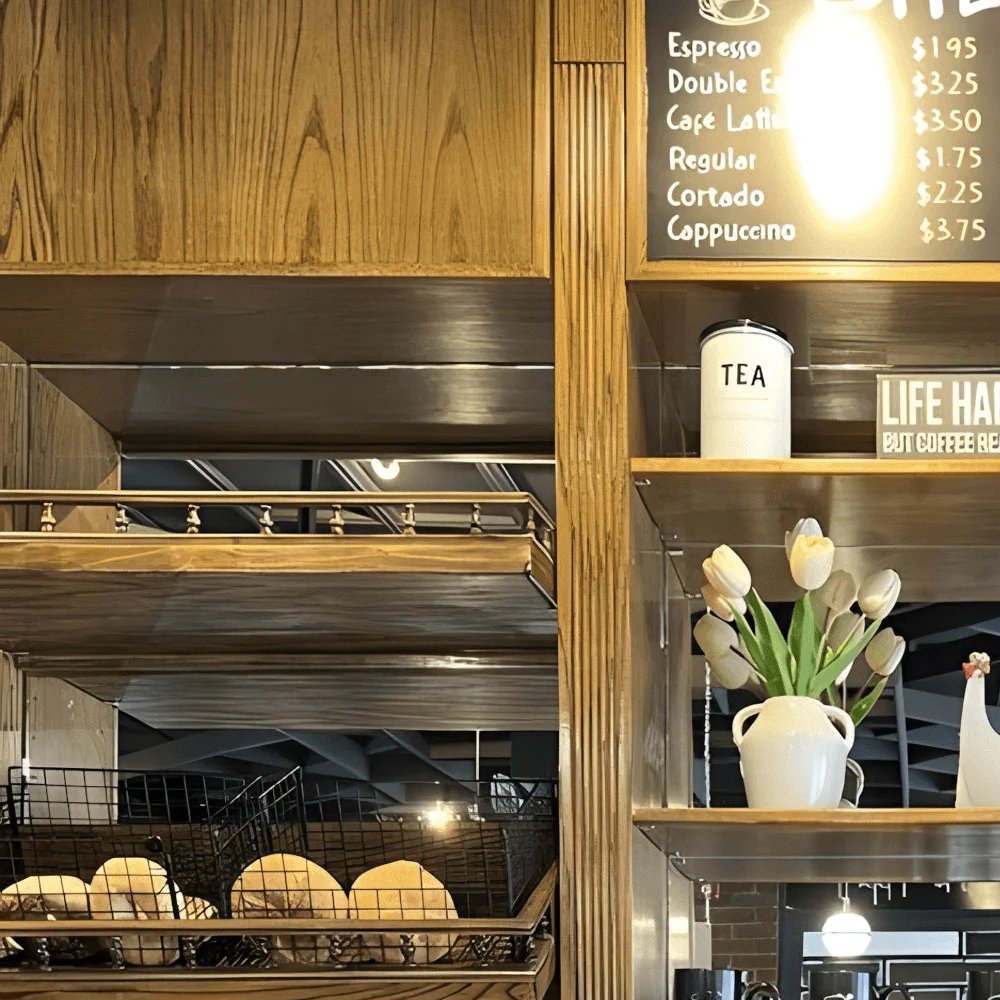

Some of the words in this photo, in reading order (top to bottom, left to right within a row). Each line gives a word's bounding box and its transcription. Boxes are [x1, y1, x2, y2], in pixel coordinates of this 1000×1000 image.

[668, 32, 762, 64] Espresso
[668, 68, 748, 94] Double
[669, 146, 757, 173] Regular
[667, 182, 765, 207] Cortado
[667, 214, 797, 247] Cappuccino
[721, 363, 766, 388] TEA
[882, 380, 943, 425] LIFE
[916, 432, 975, 454] COFFEE
